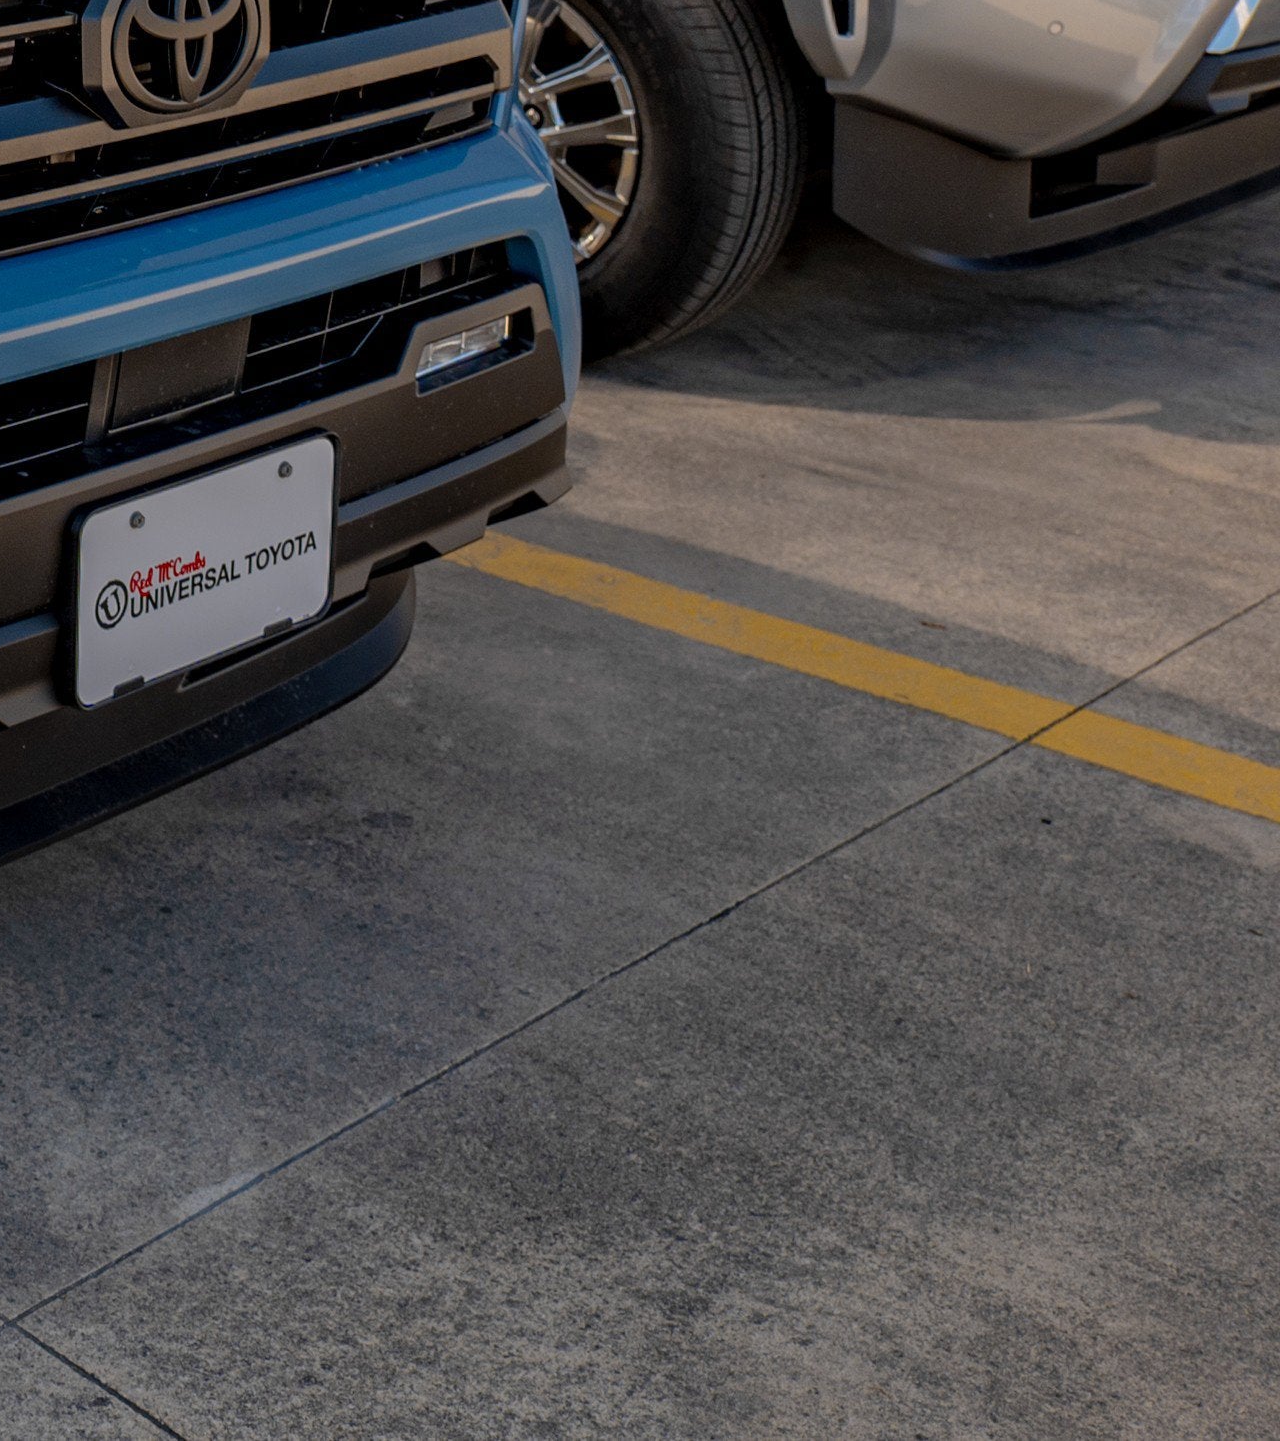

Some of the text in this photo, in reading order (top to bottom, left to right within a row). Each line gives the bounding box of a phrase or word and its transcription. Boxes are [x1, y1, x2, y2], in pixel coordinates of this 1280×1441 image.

[130, 551, 206, 597] Red McCombs
[130, 531, 317, 618] UNIVERSAL TOYOTA
